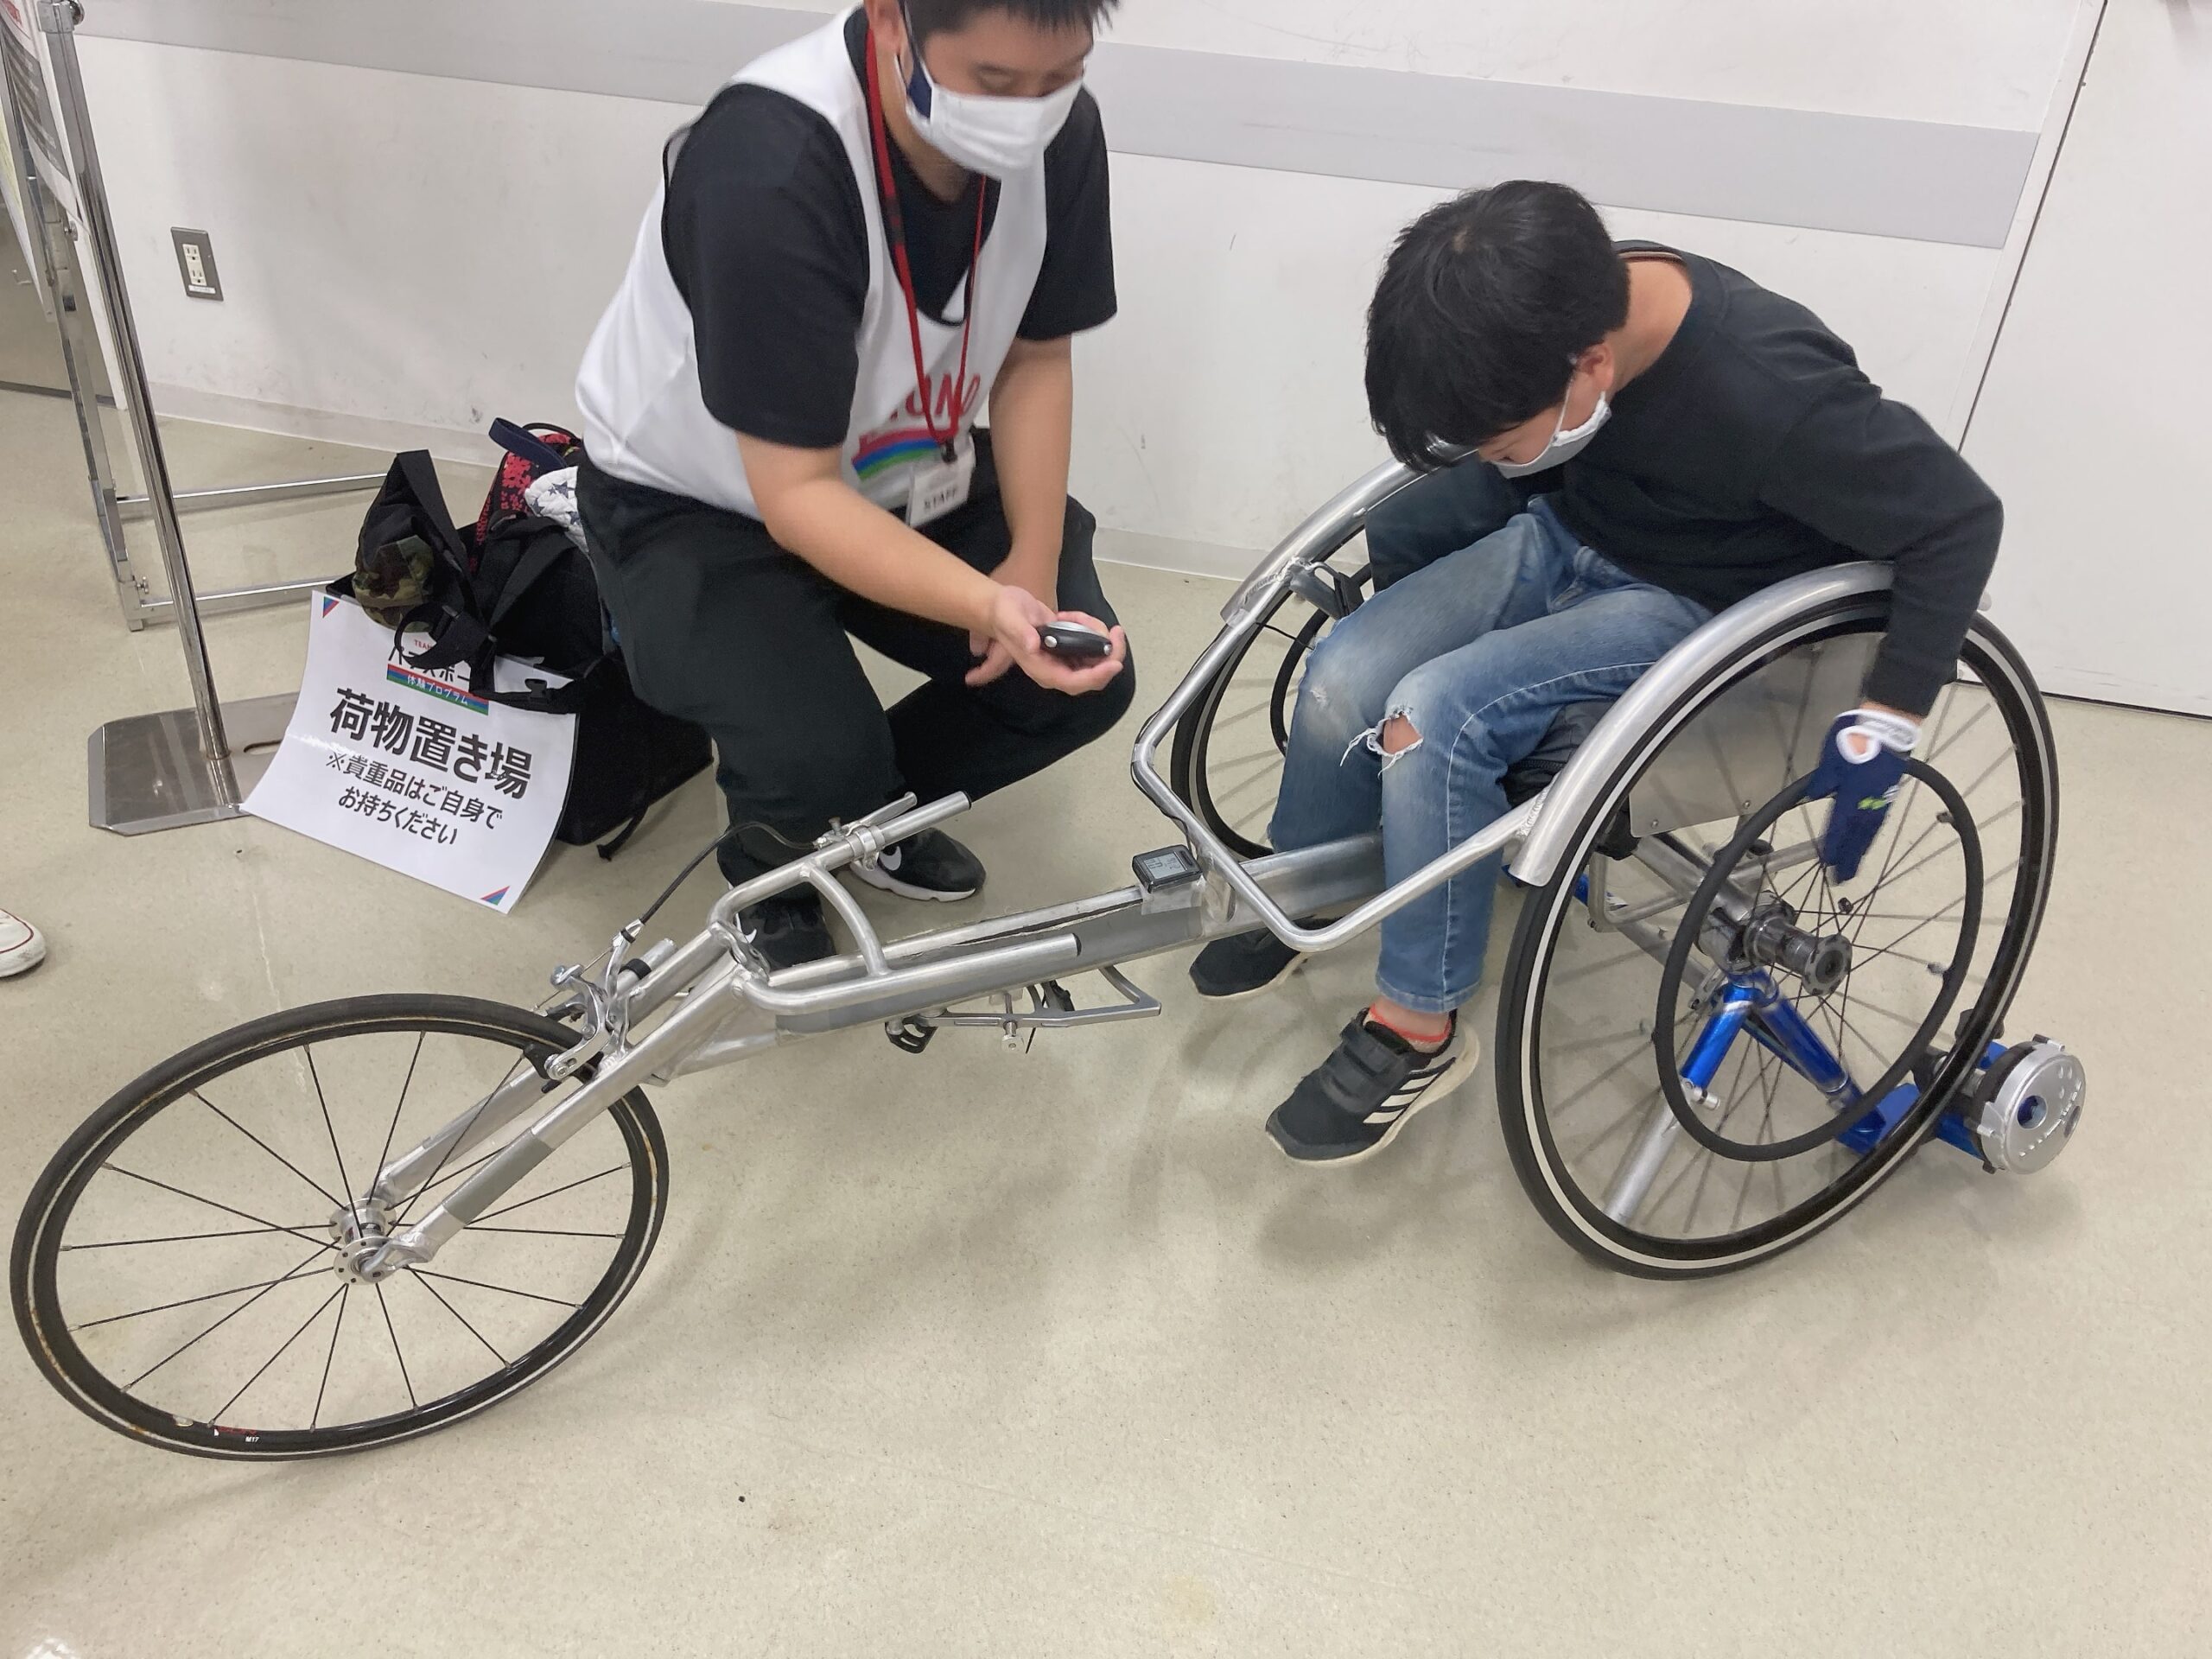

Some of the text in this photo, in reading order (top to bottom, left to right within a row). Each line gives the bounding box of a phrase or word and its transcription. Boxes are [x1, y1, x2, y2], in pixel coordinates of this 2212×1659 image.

[407, 674, 468, 705] 体験プログラム
[329, 687, 532, 800] 荷物置き場
[338, 785, 458, 845] お持ちください
